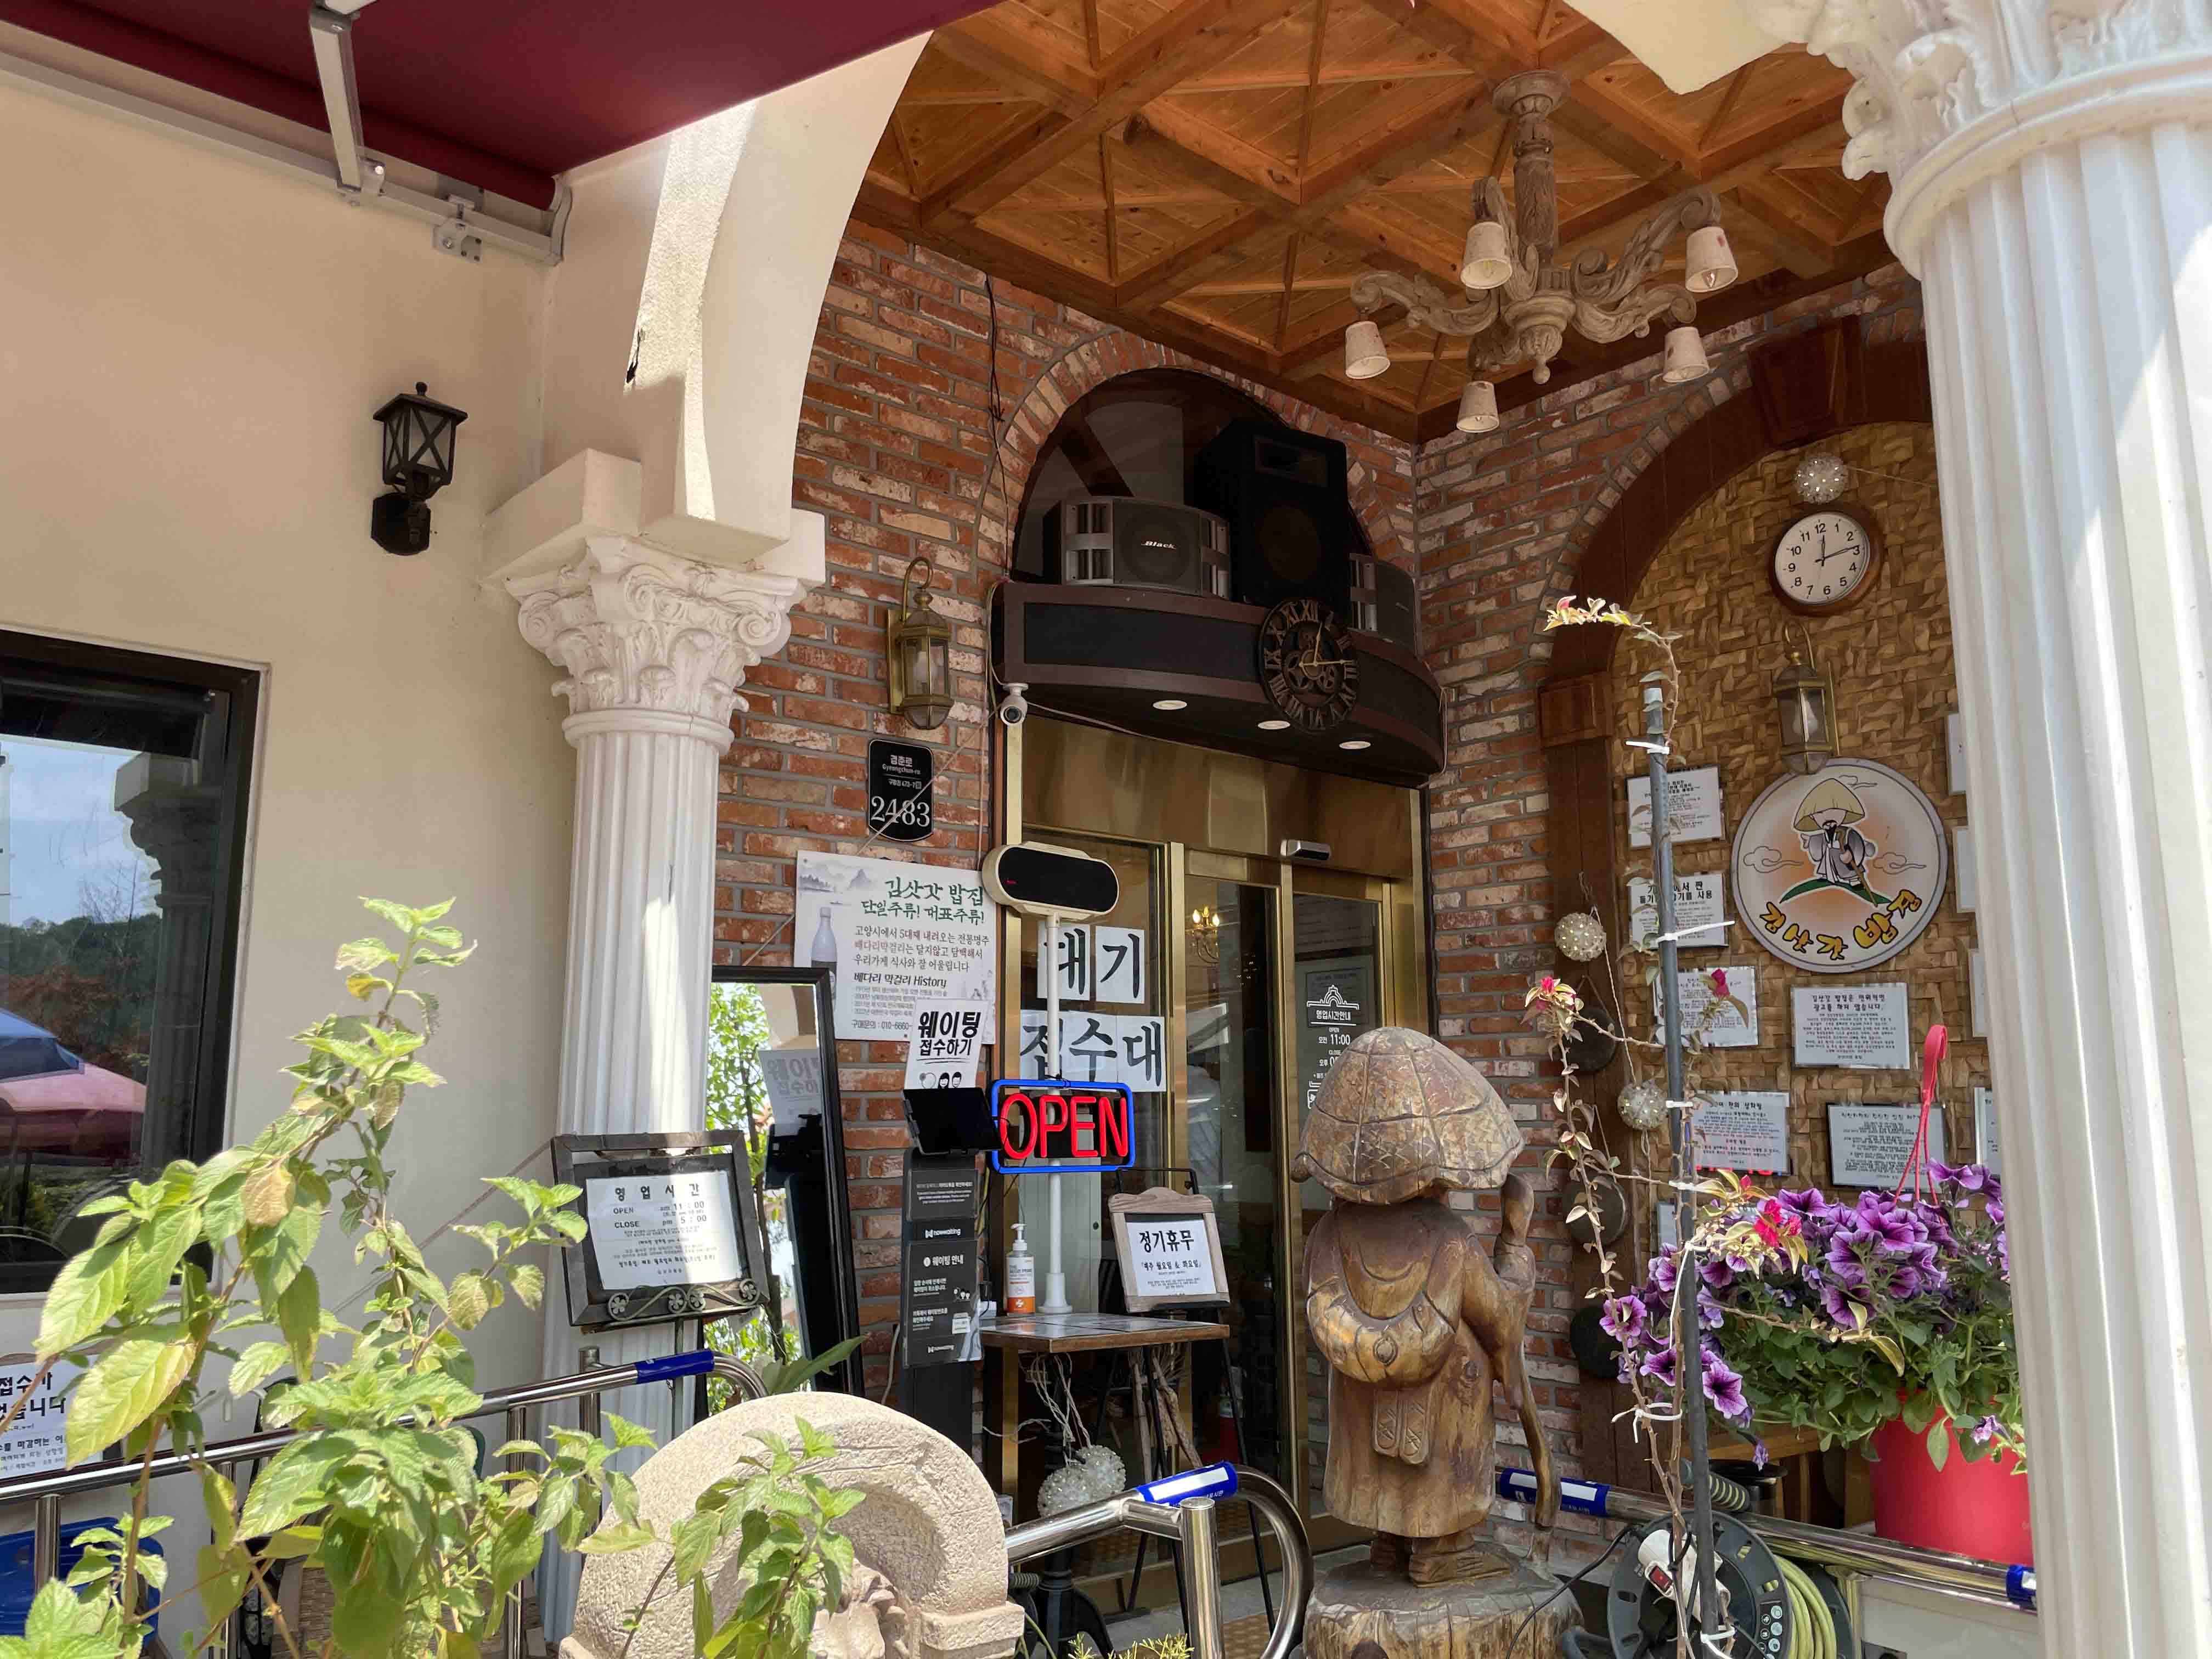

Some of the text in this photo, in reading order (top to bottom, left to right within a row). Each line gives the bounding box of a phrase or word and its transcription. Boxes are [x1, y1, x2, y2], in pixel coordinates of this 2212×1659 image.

[1815, 523, 1826, 533] 12
[1835, 523, 1839, 532] 1
[1801, 532, 1810, 541] 11
[1847, 532, 1853, 541] 2
[1791, 546, 1801, 556] 10
[1853, 545, 1860, 555] 3
[1788, 563, 1796, 572] 9
[1849, 562, 1857, 572] 4
[1795, 577, 1802, 586] 8
[1839, 577, 1847, 586] 5
[1807, 585, 1813, 595] 7
[1823, 585, 1830, 595] 6
[871, 796, 930, 827] 2483
[884, 876, 984, 906] 김삿갓 밥집
[1697, 890, 1712, 899] 사용
[861, 900, 984, 926] 단일주류! 대표주류!
[855, 926, 897, 939] 고양시에서
[923, 930, 956, 944] 내려오는
[958, 933, 990, 946] 전통명주
[853, 953, 969, 973] 우리가게 식사와 잘 어울립니다
[854, 972, 947, 988] 배다리 막걸리 History
[1316, 1010, 1351, 1021] 영업시간안내
[918, 1011, 981, 1038] 웨이팅
[1330, 1034, 1351, 1045] 11:00
[919, 1039, 972, 1056] 접수하기
[1000, 1093, 1128, 1159] OPEN
[1139, 1231, 1194, 1253] 정기휴무
[933, 1255, 964, 1266] 웨이팅 안내
